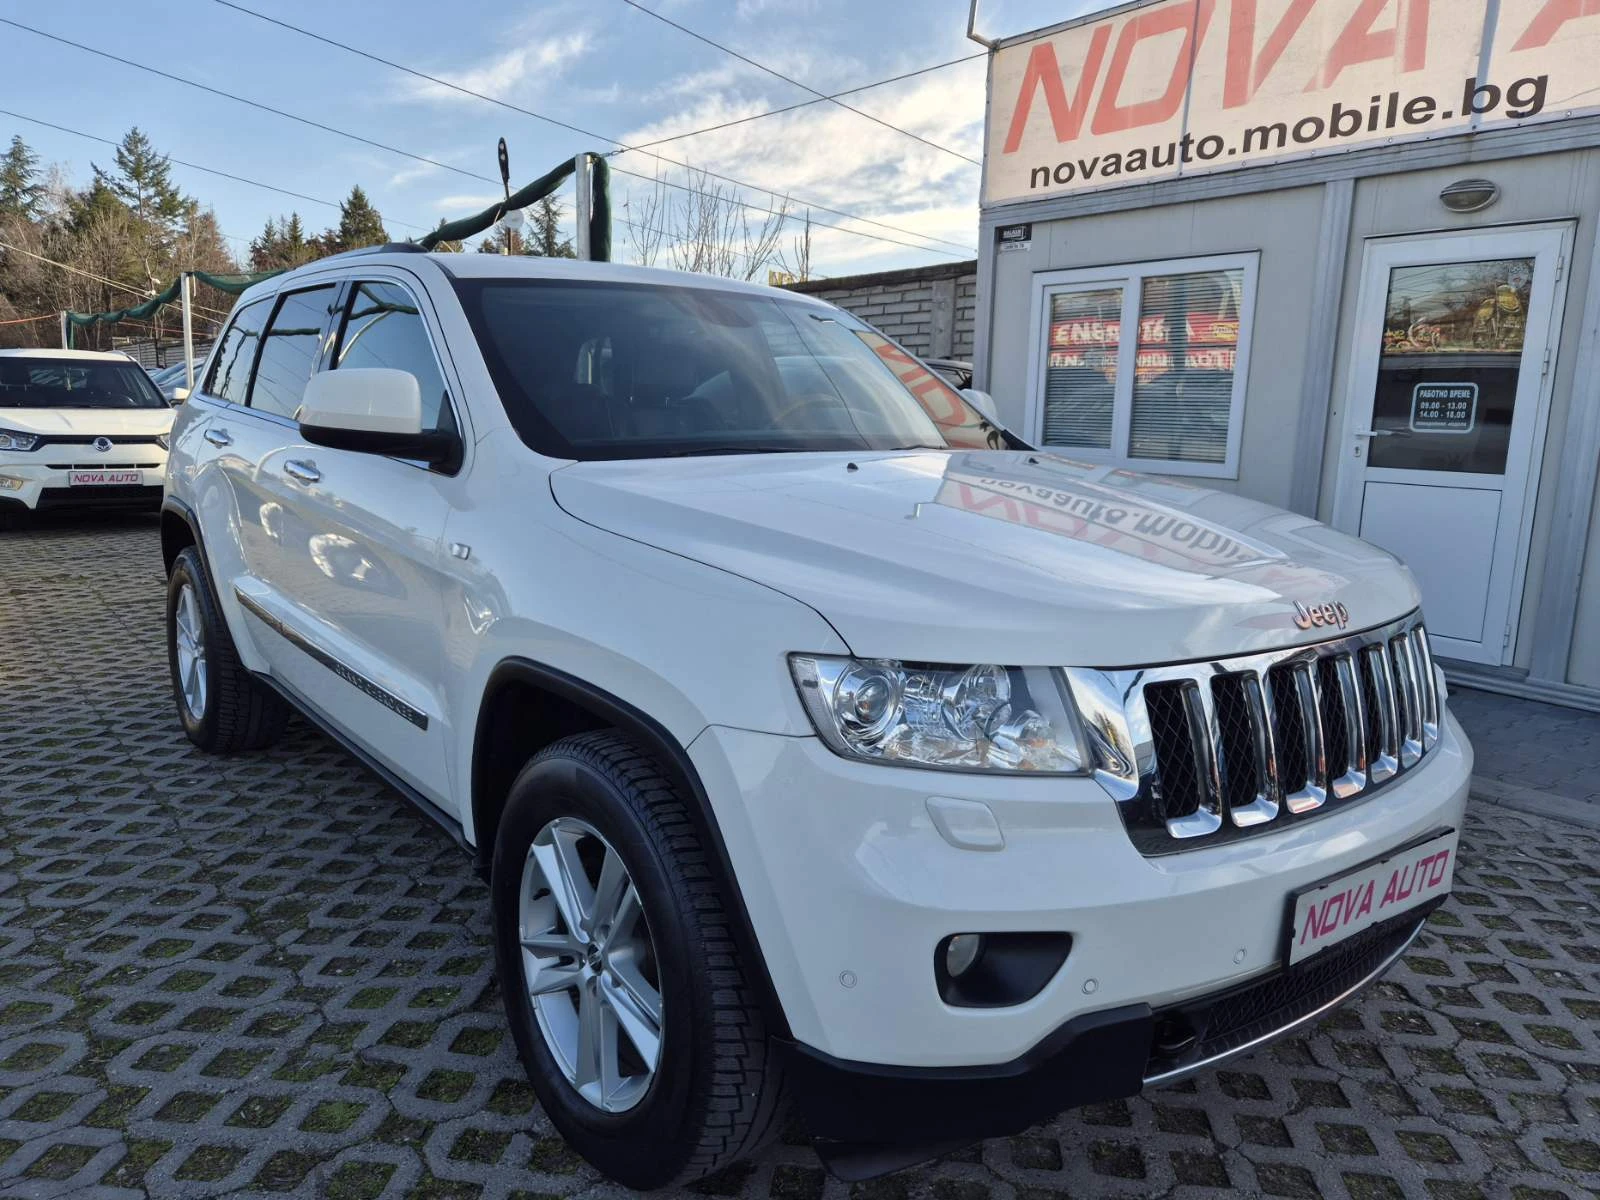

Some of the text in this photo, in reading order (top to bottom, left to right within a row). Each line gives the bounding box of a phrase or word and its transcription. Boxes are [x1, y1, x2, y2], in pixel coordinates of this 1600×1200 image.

[1003, 0, 1429, 154] NOVA
[1030, 75, 1548, 188] novaauto.mobile.bg
[109, 474, 138, 482] AUTO
[1293, 599, 1348, 630] Jeep
[1301, 849, 1450, 945] NOVA AUTO
